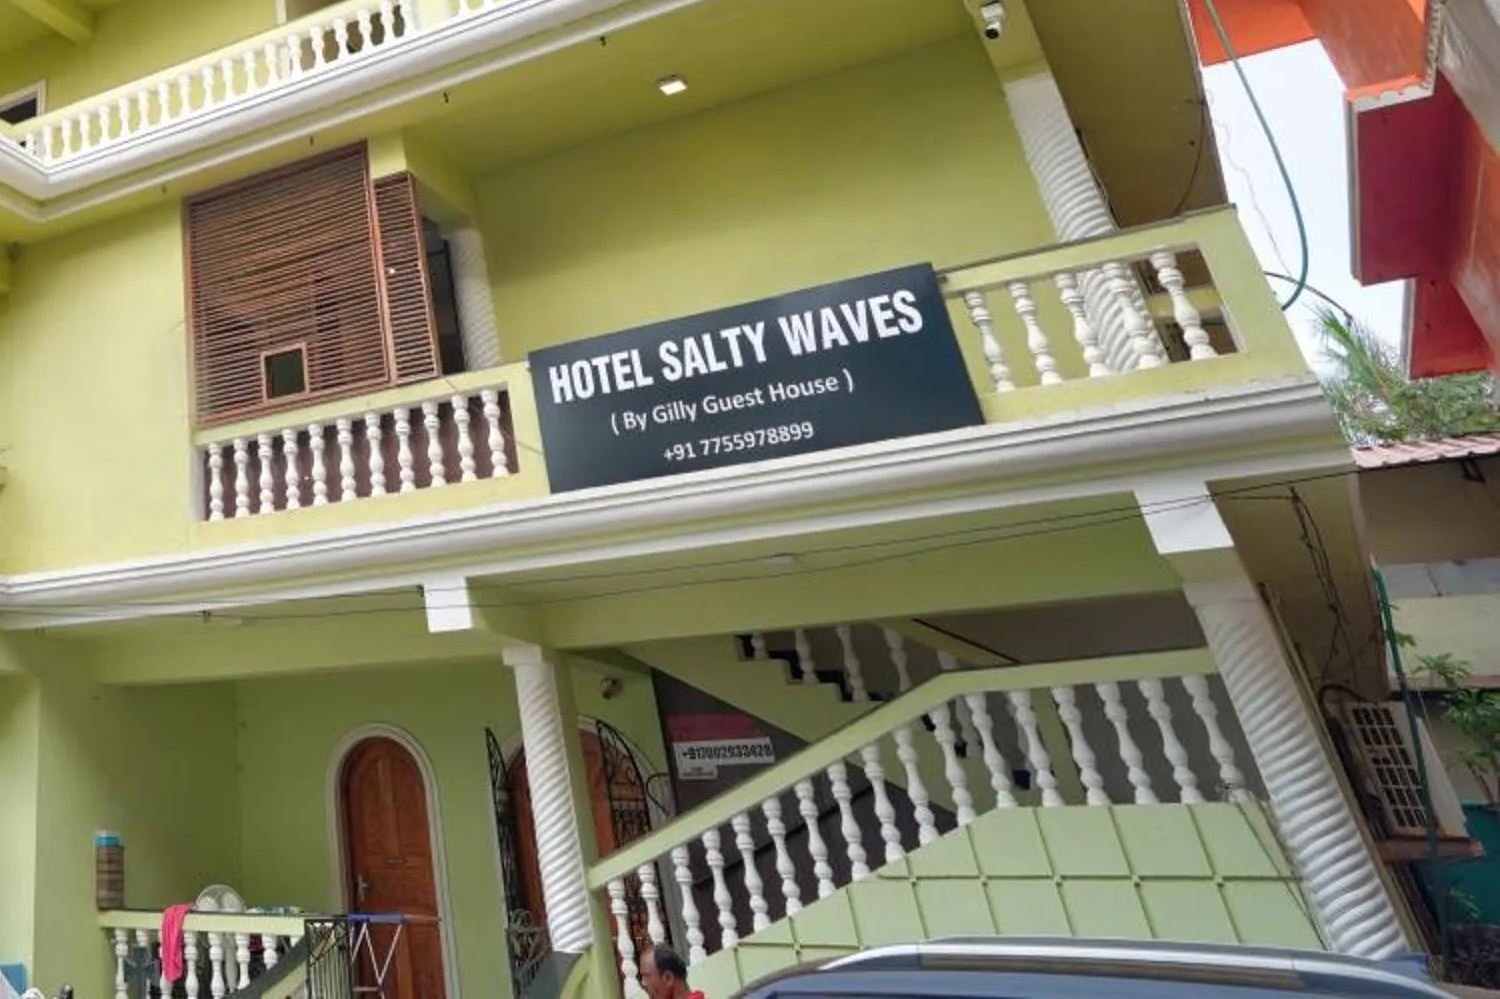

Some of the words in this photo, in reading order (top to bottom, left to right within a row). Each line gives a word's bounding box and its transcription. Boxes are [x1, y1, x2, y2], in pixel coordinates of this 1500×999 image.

[549, 349, 654, 404] HOTEL
[659, 321, 767, 382] SALTY
[777, 289, 923, 357] WAVES
[652, 400, 697, 424] Gilly
[703, 387, 765, 414] Guest
[664, 442, 697, 461] +91
[700, 421, 815, 456] 7755978899
